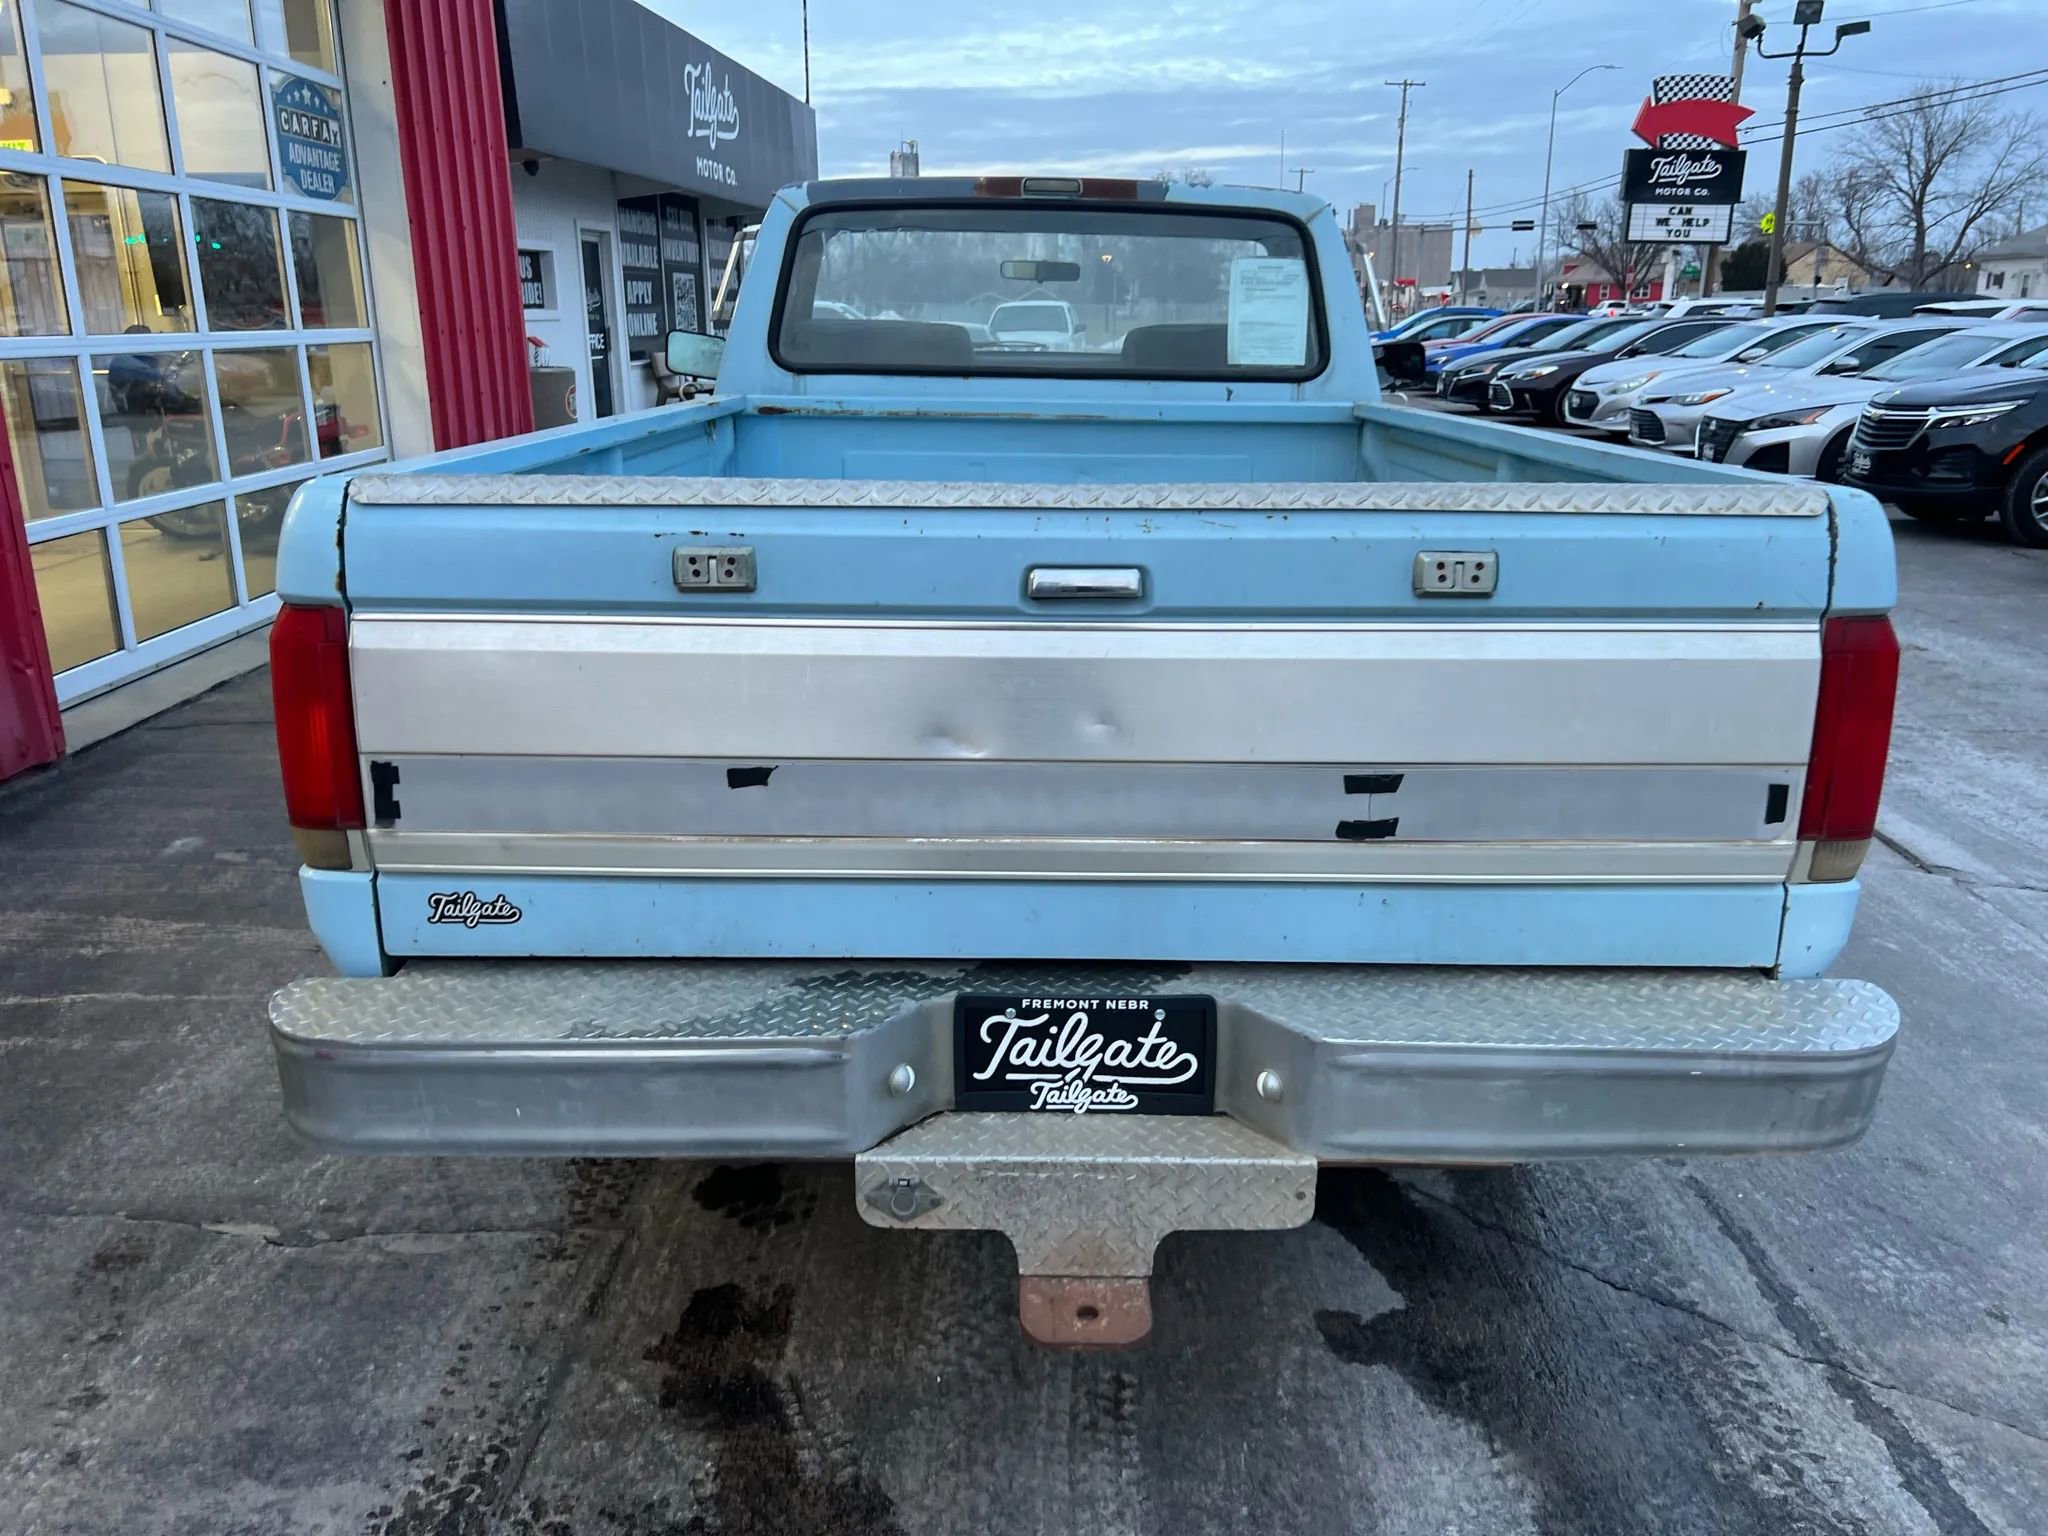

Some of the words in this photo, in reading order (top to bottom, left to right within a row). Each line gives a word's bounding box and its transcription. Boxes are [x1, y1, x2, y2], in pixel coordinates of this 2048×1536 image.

[684, 62, 739, 150] Tailgate
[281, 111, 340, 146] CARFAX
[288, 142, 341, 172] ADVANTAGE
[1648, 153, 1722, 185] Tailgate
[300, 169, 335, 194] DEALER
[696, 156, 723, 182] MOTOR
[725, 165, 738, 187] CO.
[1655, 187, 1691, 196] MOTOR
[1656, 218, 1671, 227] WE
[1681, 218, 1710, 227] HELP
[1668, 206, 1693, 216] CAN
[1666, 229, 1691, 238] YOU
[626, 280, 652, 304] APPLY
[627, 312, 659, 337] ONLINE
[429, 892, 521, 928] Tailgate
[1021, 999, 1100, 1010] FREMONT
[1106, 999, 1149, 1011] NEBR
[973, 1012, 1198, 1085] Tailgate
[1030, 1079, 1139, 1114] Tailgate
